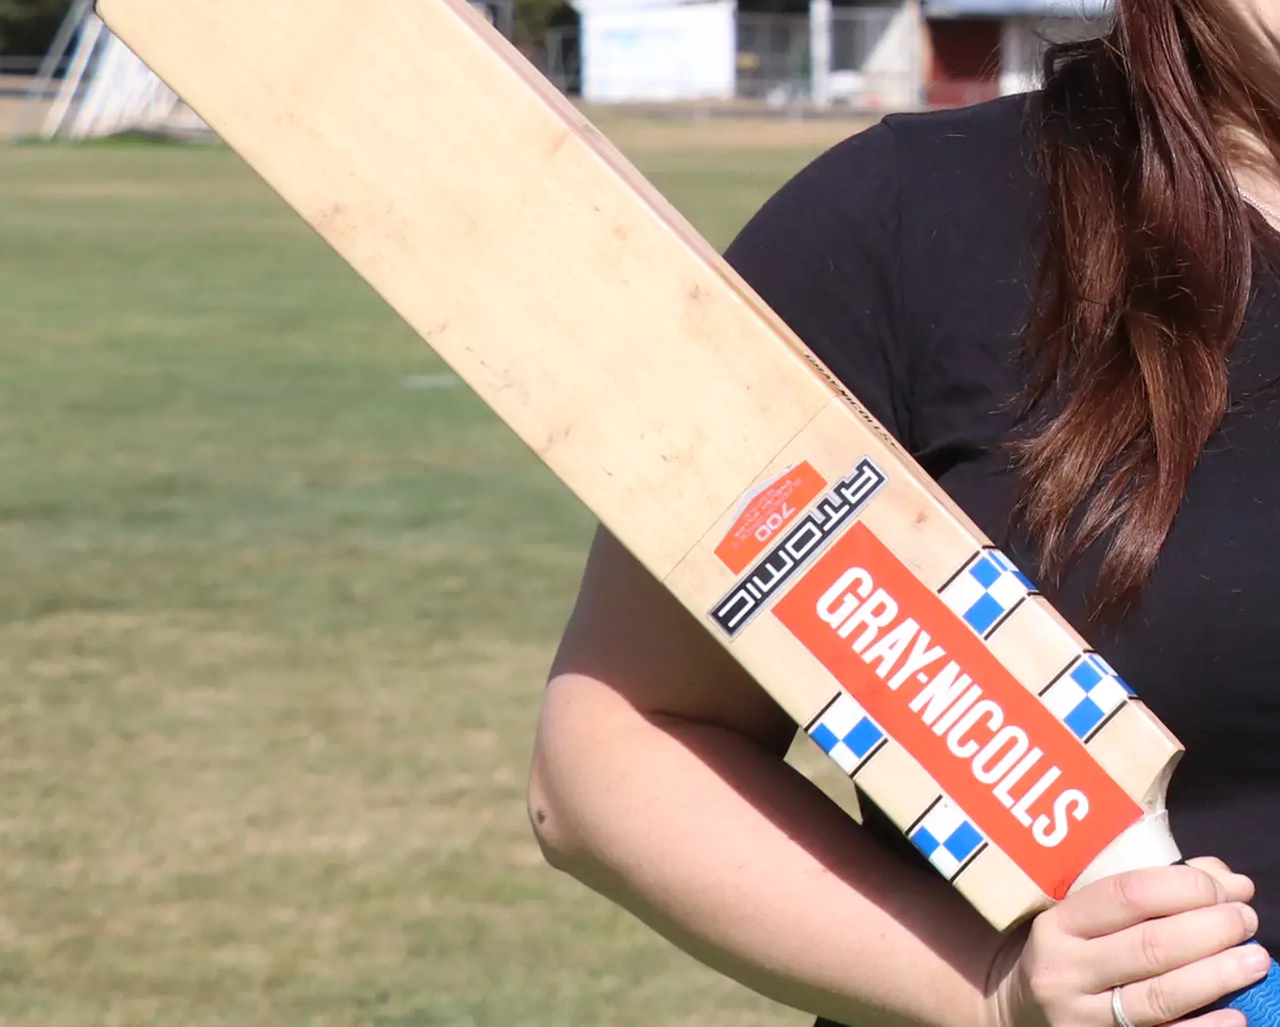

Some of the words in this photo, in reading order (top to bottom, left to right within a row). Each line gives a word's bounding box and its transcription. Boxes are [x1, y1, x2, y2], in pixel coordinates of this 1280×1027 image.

[717, 464, 879, 628] ATOMIC
[754, 502, 796, 542] 700
[816, 566, 1089, 848] GRAY-NICOLLS
